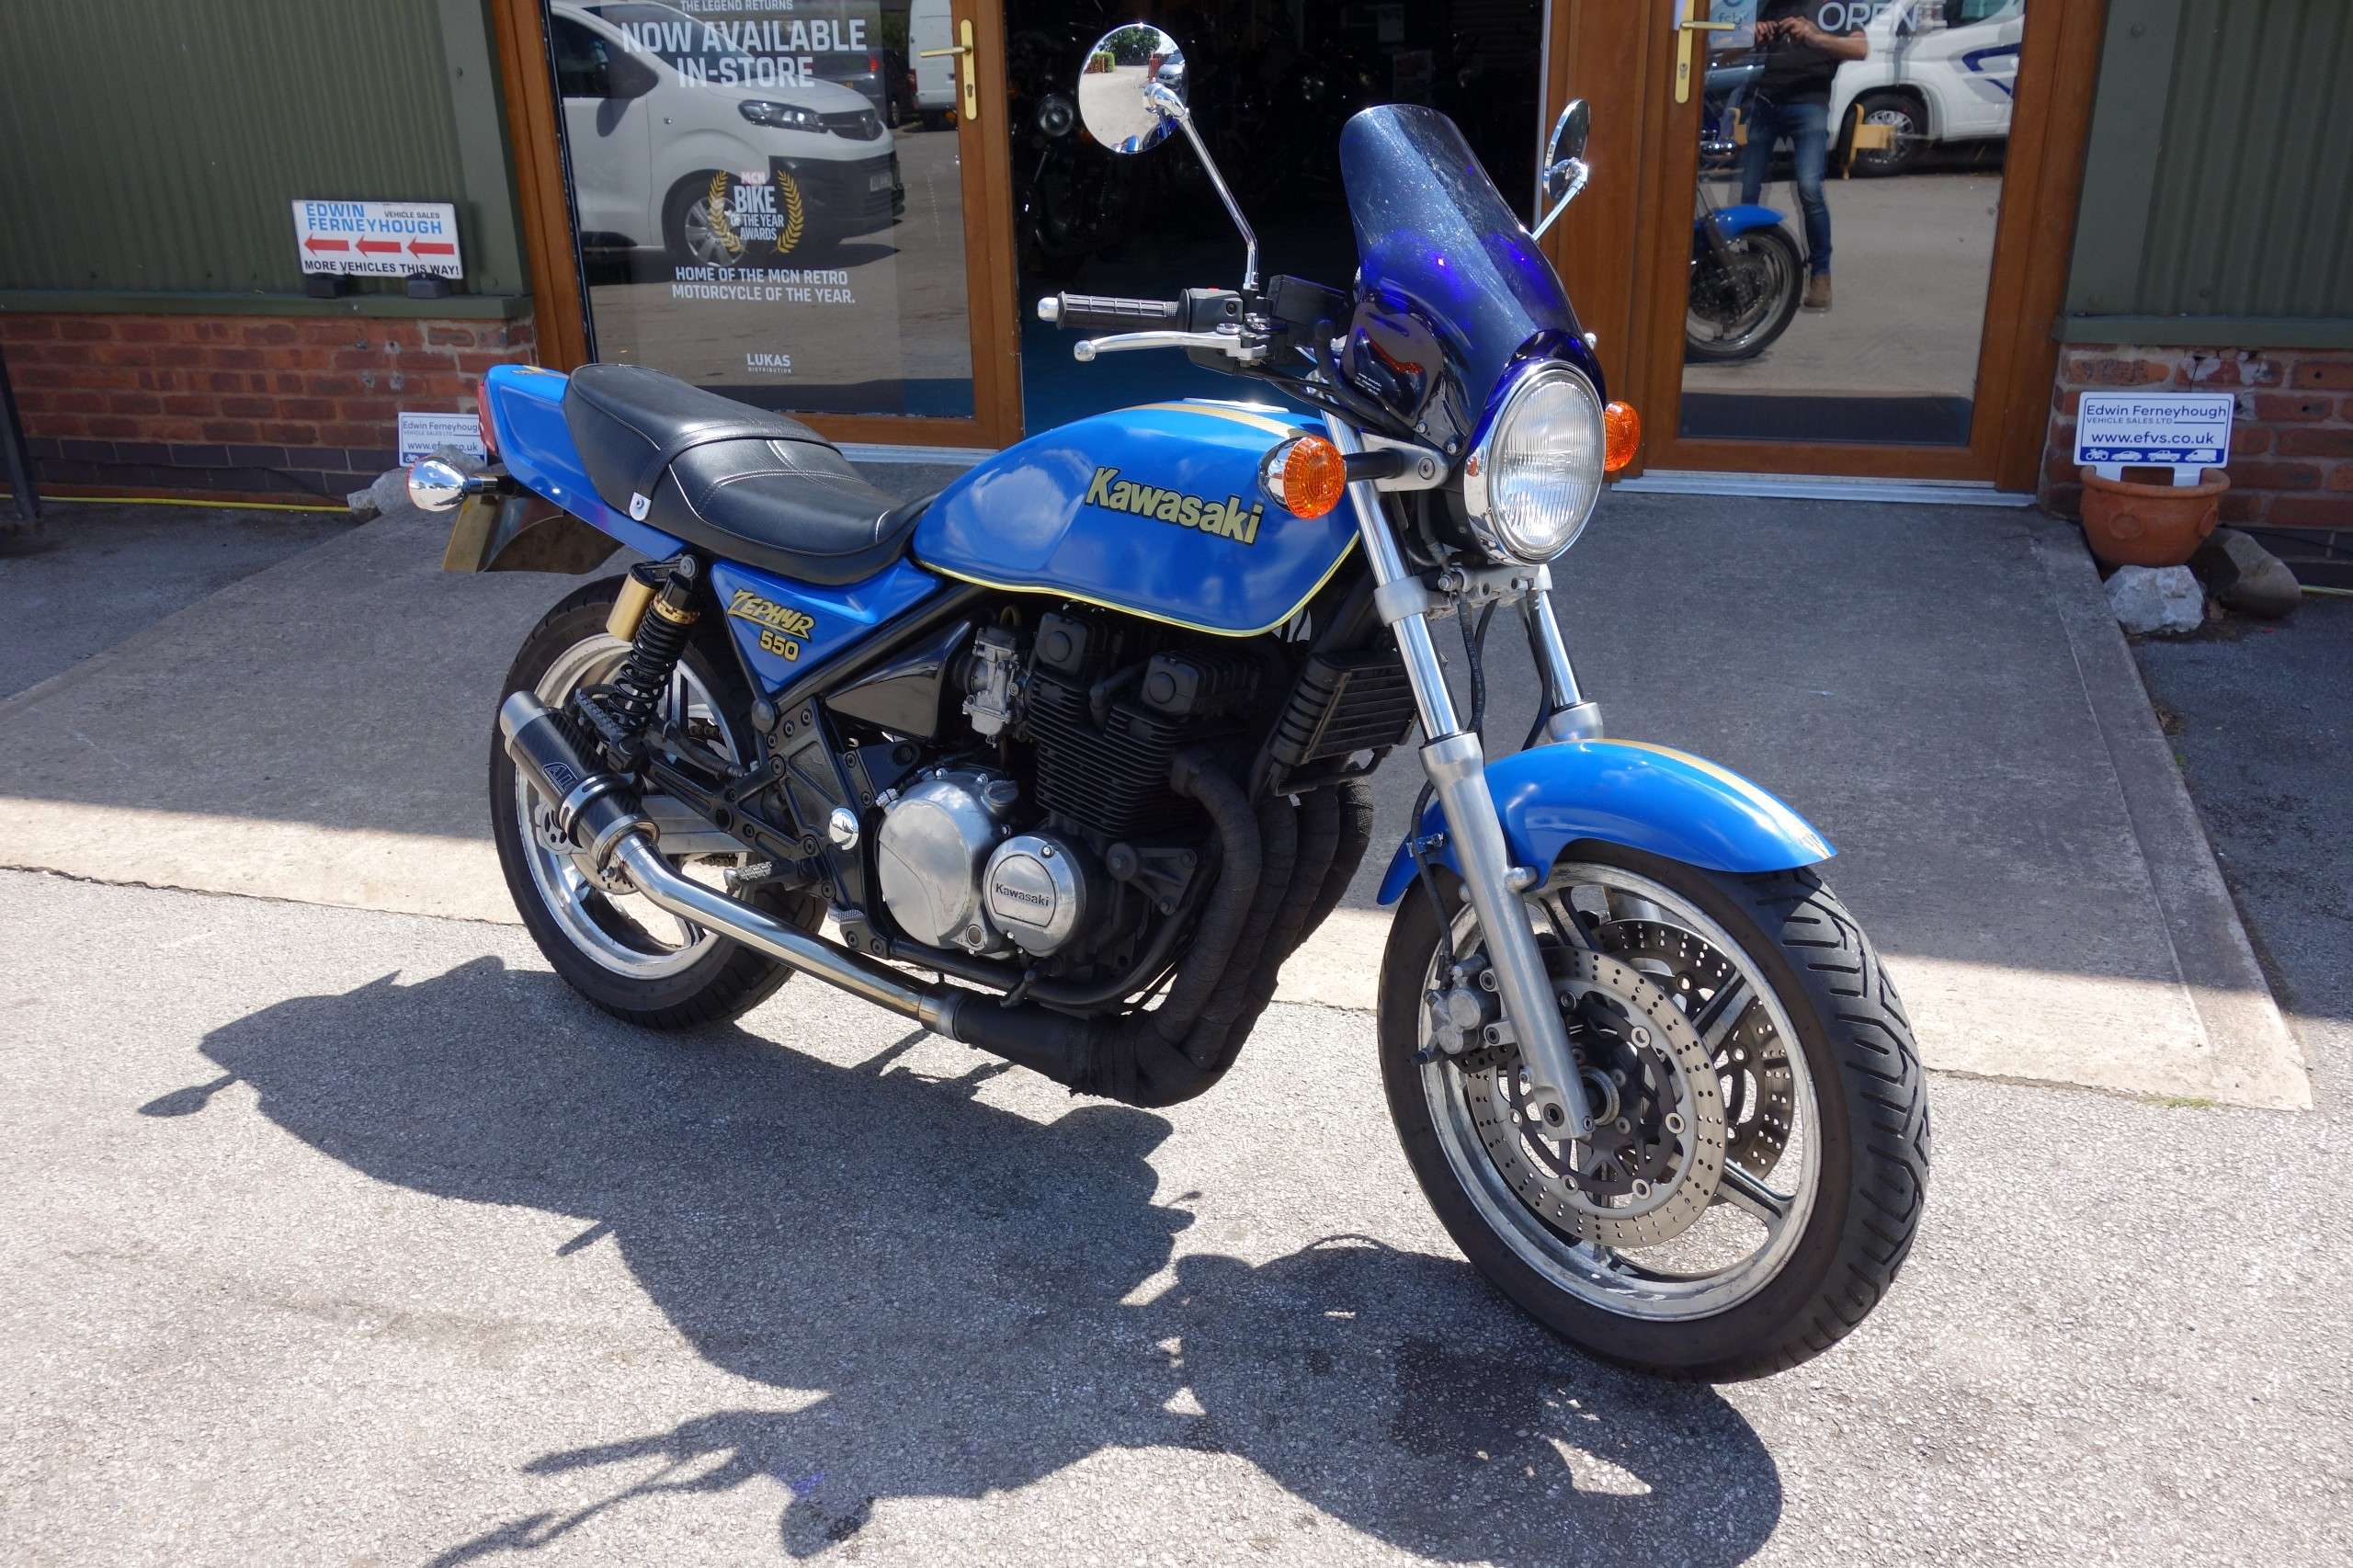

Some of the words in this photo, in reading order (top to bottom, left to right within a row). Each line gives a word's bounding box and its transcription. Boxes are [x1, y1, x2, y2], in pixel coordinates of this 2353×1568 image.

[681, 0, 699, 11] THE
[702, 0, 742, 11] LEGEND
[745, 0, 793, 11] RETURNS
[621, 21, 690, 52] NOW
[702, 19, 867, 52] AVAILABLE
[677, 56, 815, 88] IN-STORE
[733, 186, 777, 213] BIKE
[305, 203, 365, 218] EDWIN
[384, 210, 414, 219] VEHICLE
[308, 217, 442, 234] FERNEYHOUGH
[744, 214, 760, 227] THE
[760, 214, 784, 228] YEAR
[740, 227, 777, 240] AWARDS
[304, 260, 336, 271] MORE
[342, 261, 396, 273] VEHICLES
[400, 264, 426, 275] THIS
[429, 265, 460, 276] WAY!
[676, 267, 715, 281] HOME
[718, 267, 735, 282] OF
[738, 268, 765, 283] THE
[768, 269, 801, 284] MCN
[804, 269, 847, 285] RETRO
[672, 284, 762, 301] MOTORCYCLE
[765, 287, 783, 301] OF
[786, 288, 812, 302] THE
[814, 289, 856, 303] YEAR.
[746, 353, 791, 367] LUKAS
[2087, 404, 2129, 415] Edwin
[2133, 405, 2226, 419] Ferneyhough
[429, 422, 479, 433] Ferneyhoug
[2091, 431, 2214, 444] www.efvs.co.uk
[1086, 467, 1265, 545] Kawasaki
[759, 630, 799, 661] 550
[995, 883, 1049, 906] Kawasaki
